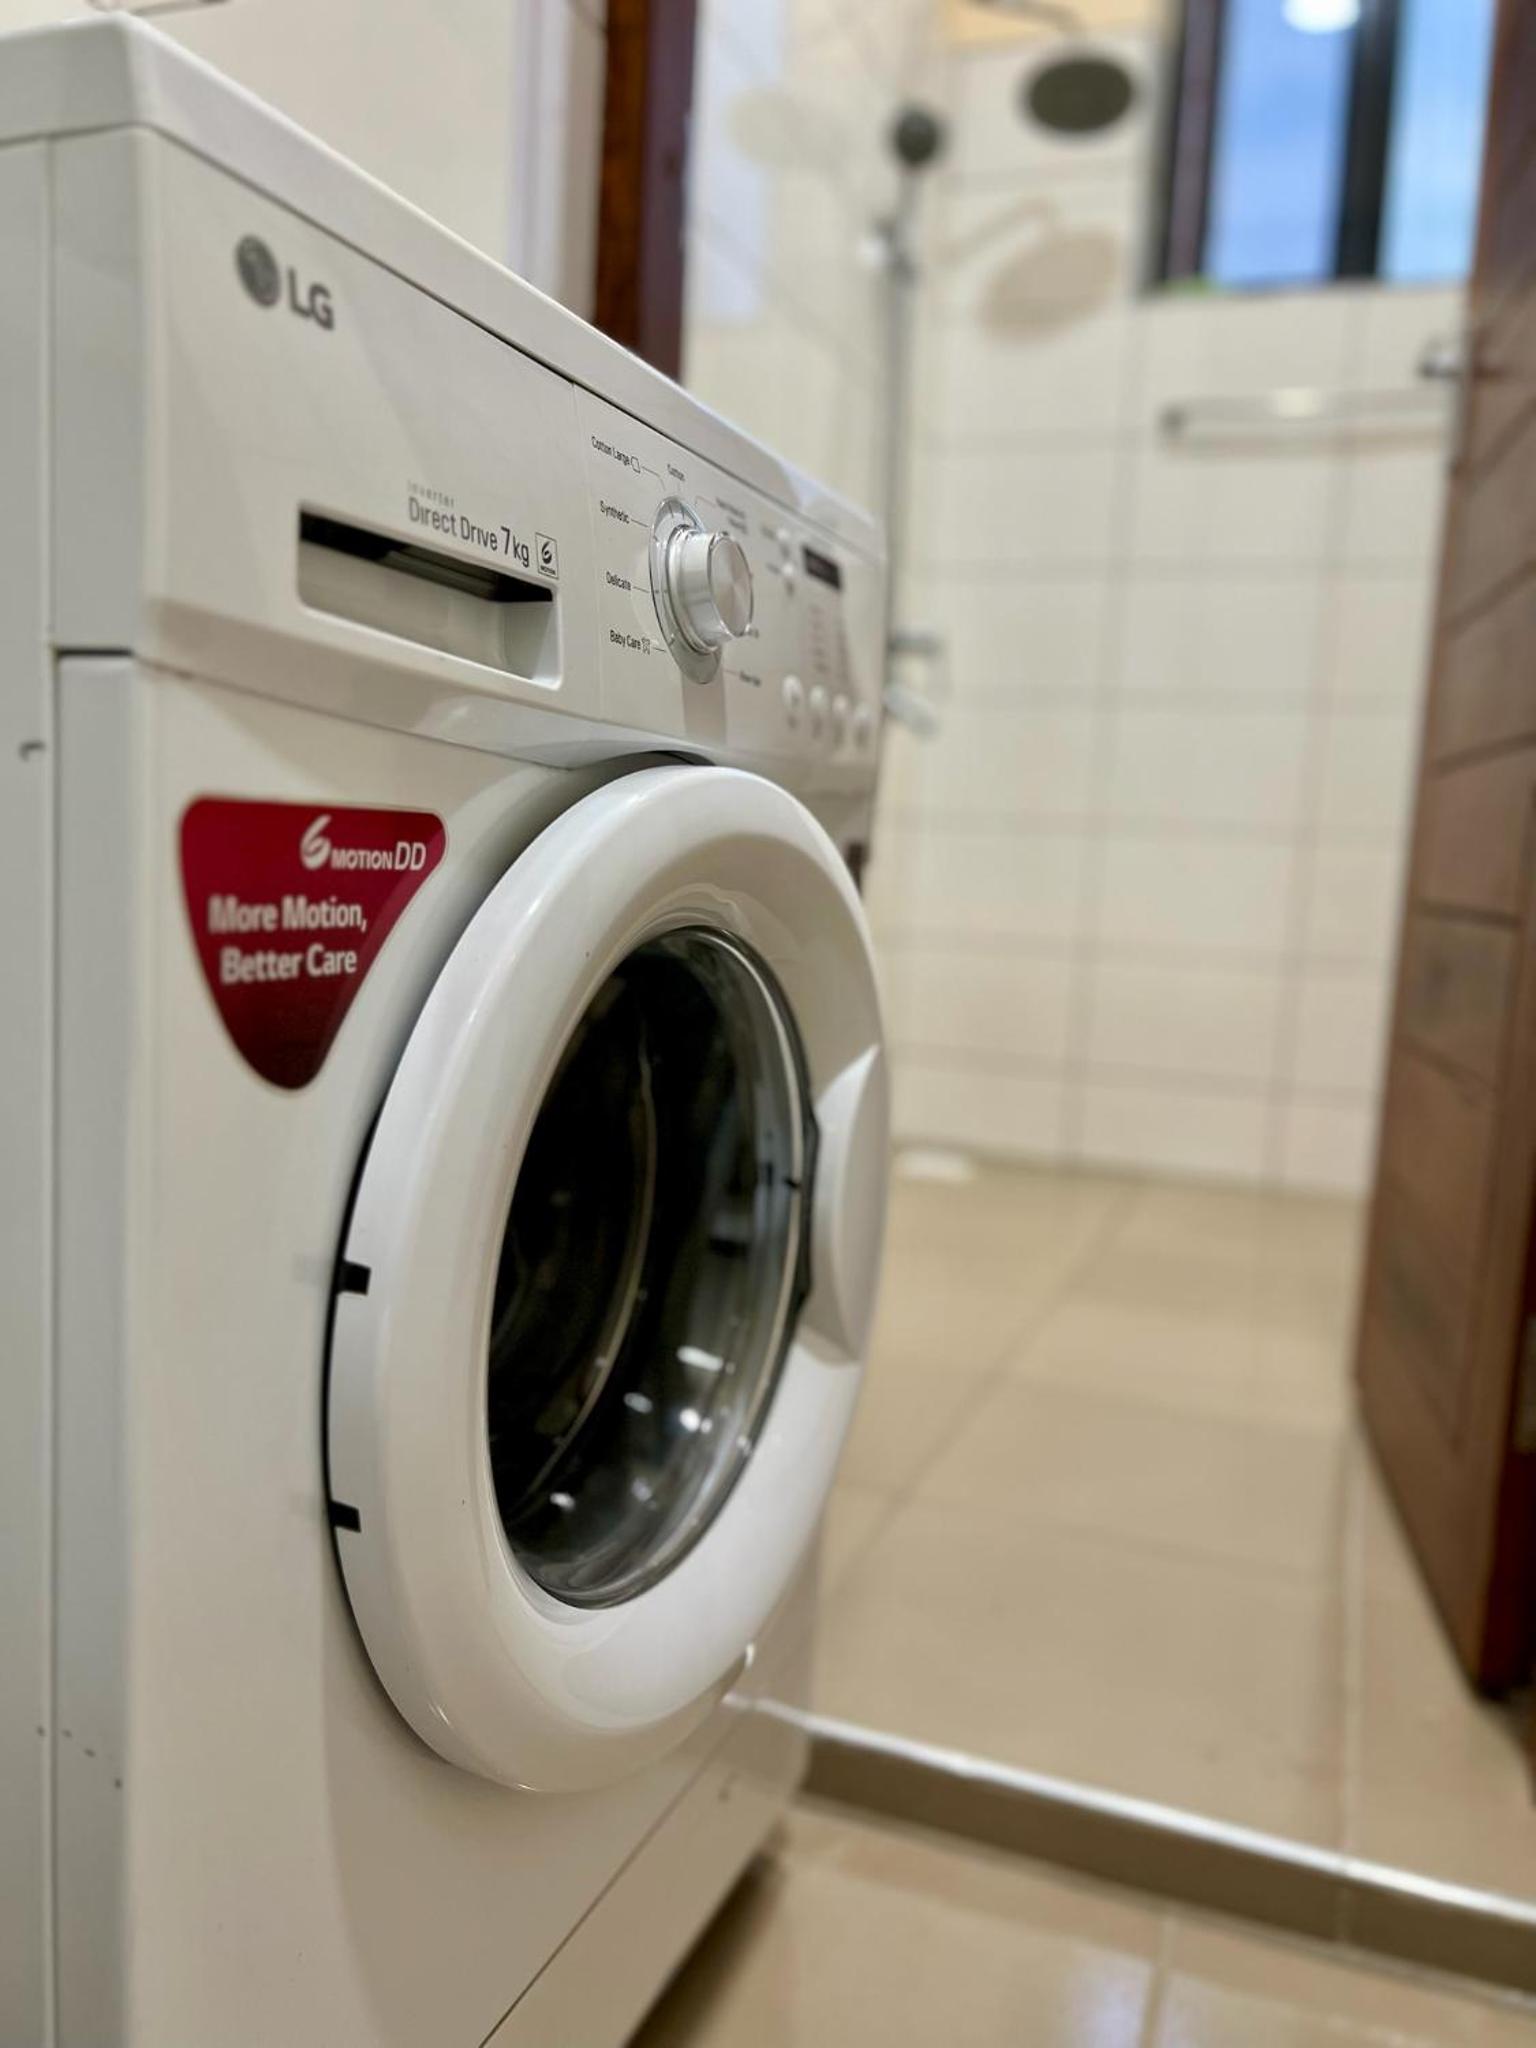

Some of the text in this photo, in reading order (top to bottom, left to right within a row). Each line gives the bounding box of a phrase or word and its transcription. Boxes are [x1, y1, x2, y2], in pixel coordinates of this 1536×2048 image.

[288, 265, 335, 331] LG
[592, 436, 630, 466] Cotton Large
[409, 496, 457, 537] Direct
[461, 516, 498, 551] Drive
[606, 571, 631, 591] Delicate
[610, 629, 641, 650] Baby Care
[207, 894, 367, 933] More Motion,
[219, 943, 357, 985] Better Care
